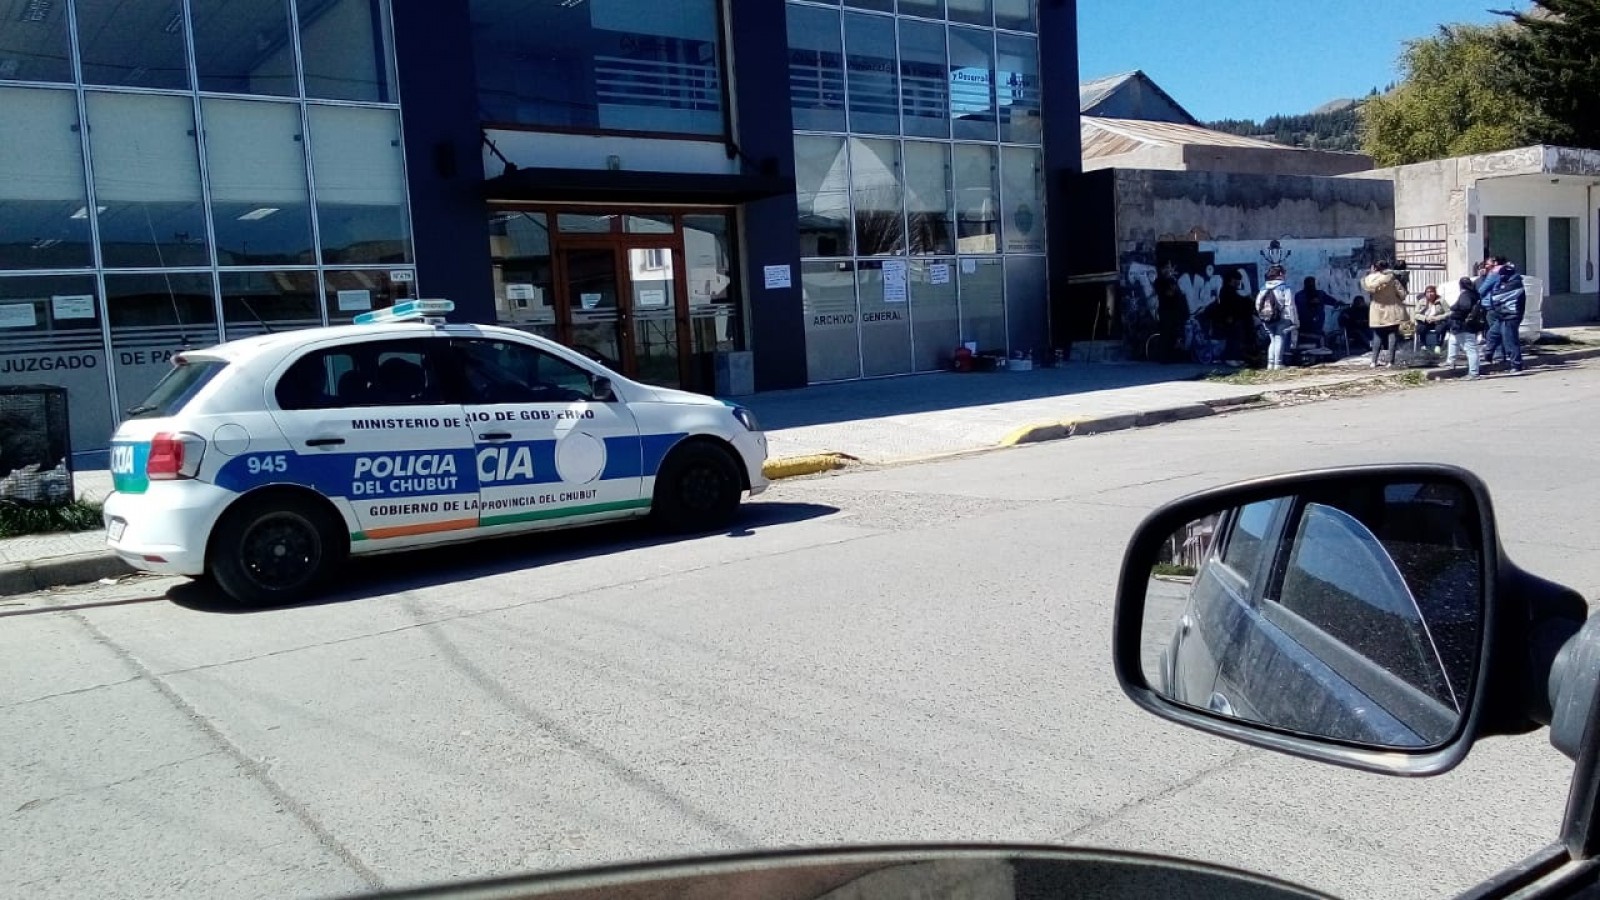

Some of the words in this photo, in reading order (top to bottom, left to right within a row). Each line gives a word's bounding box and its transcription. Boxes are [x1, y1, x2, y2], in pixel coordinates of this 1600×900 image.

[814, 314, 855, 326] ARCHIVO
[863, 311, 902, 322] GENERAL
[1, 354, 97, 373] JUZGADO
[120, 351, 146, 366] DE
[352, 419, 440, 430] MINISTERIO
[443, 418, 461, 428] DE
[495, 410, 516, 421] DE
[247, 455, 288, 474] 945
[354, 454, 457, 479] POLICIA
[476, 446, 534, 482] CIA
[352, 480, 385, 495] DEL
[389, 476, 458, 493] CHUBUT
[369, 502, 438, 517] GOBIERNO
[443, 500, 460, 512] DE
[464, 499, 479, 511] LA
[481, 496, 536, 511] PROVINCIA
[539, 494, 557, 505] DEL
[559, 489, 598, 502] CHUBUT
